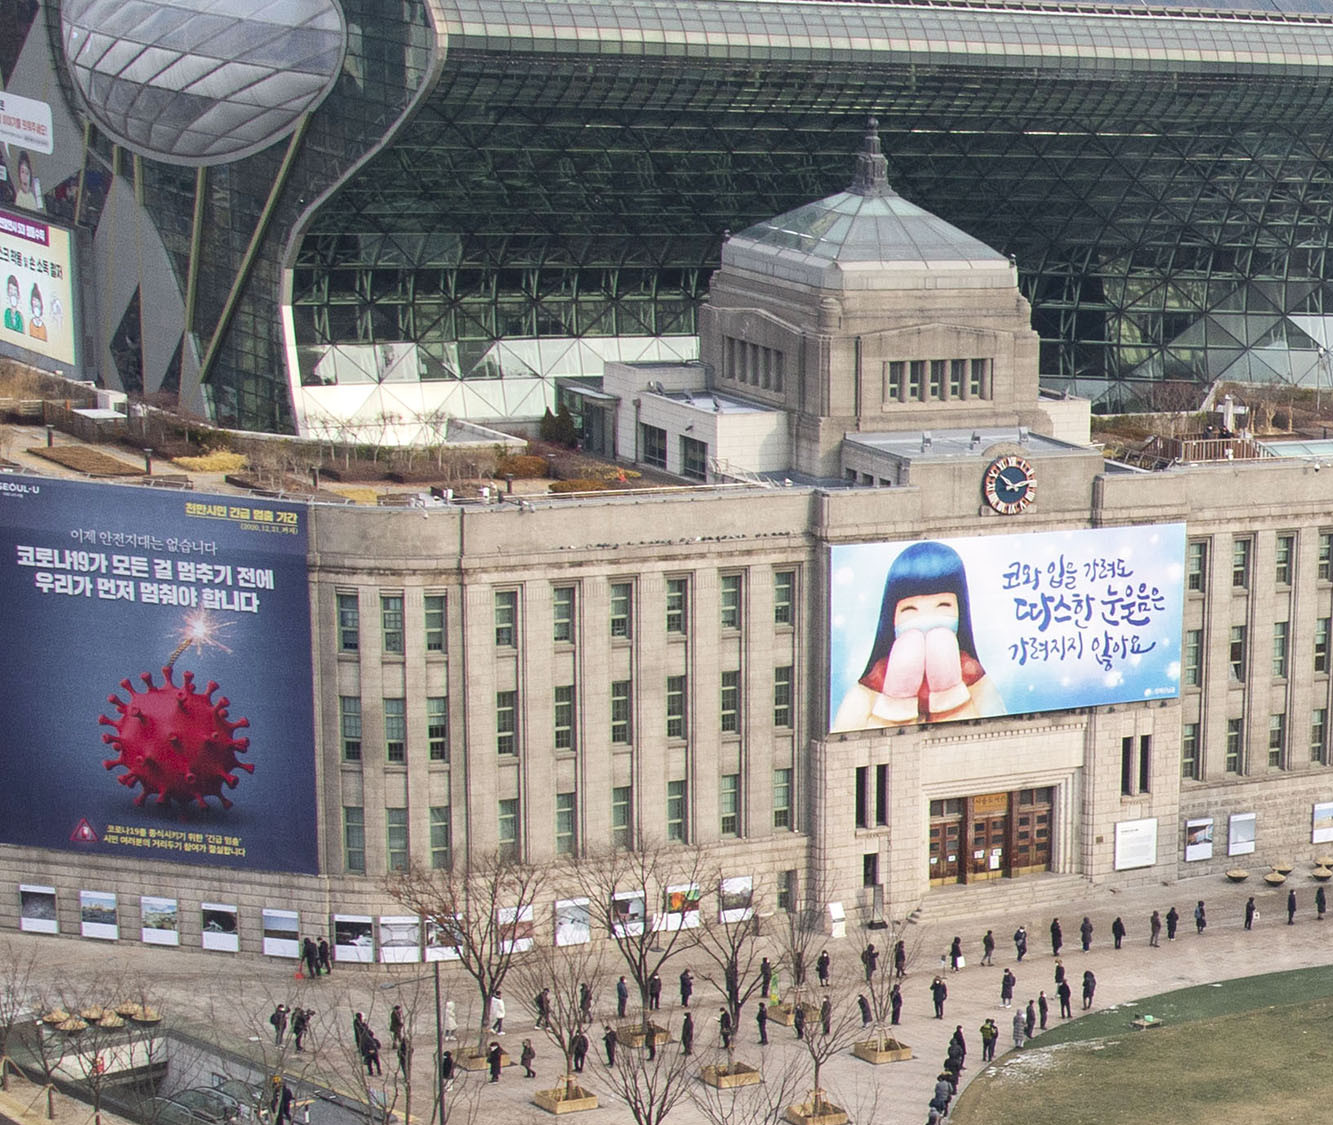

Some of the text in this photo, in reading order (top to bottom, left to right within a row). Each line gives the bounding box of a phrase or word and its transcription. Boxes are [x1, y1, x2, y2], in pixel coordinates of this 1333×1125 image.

[229, 506, 250, 520] 긴급
[276, 511, 298, 525] 기간
[70, 528, 218, 556] 이제 안전지대는 없습니다
[16, 545, 275, 590] 코로나19가 모든 걸 멈추기 전에
[1002, 554, 1134, 591] 코와 입을 가려도
[35, 572, 260, 614] 우리가 먼저 멈춰야 합니다
[1013, 582, 1166, 632] 따스한 눈웃음은
[1008, 630, 1157, 672] 가려지지 않아요
